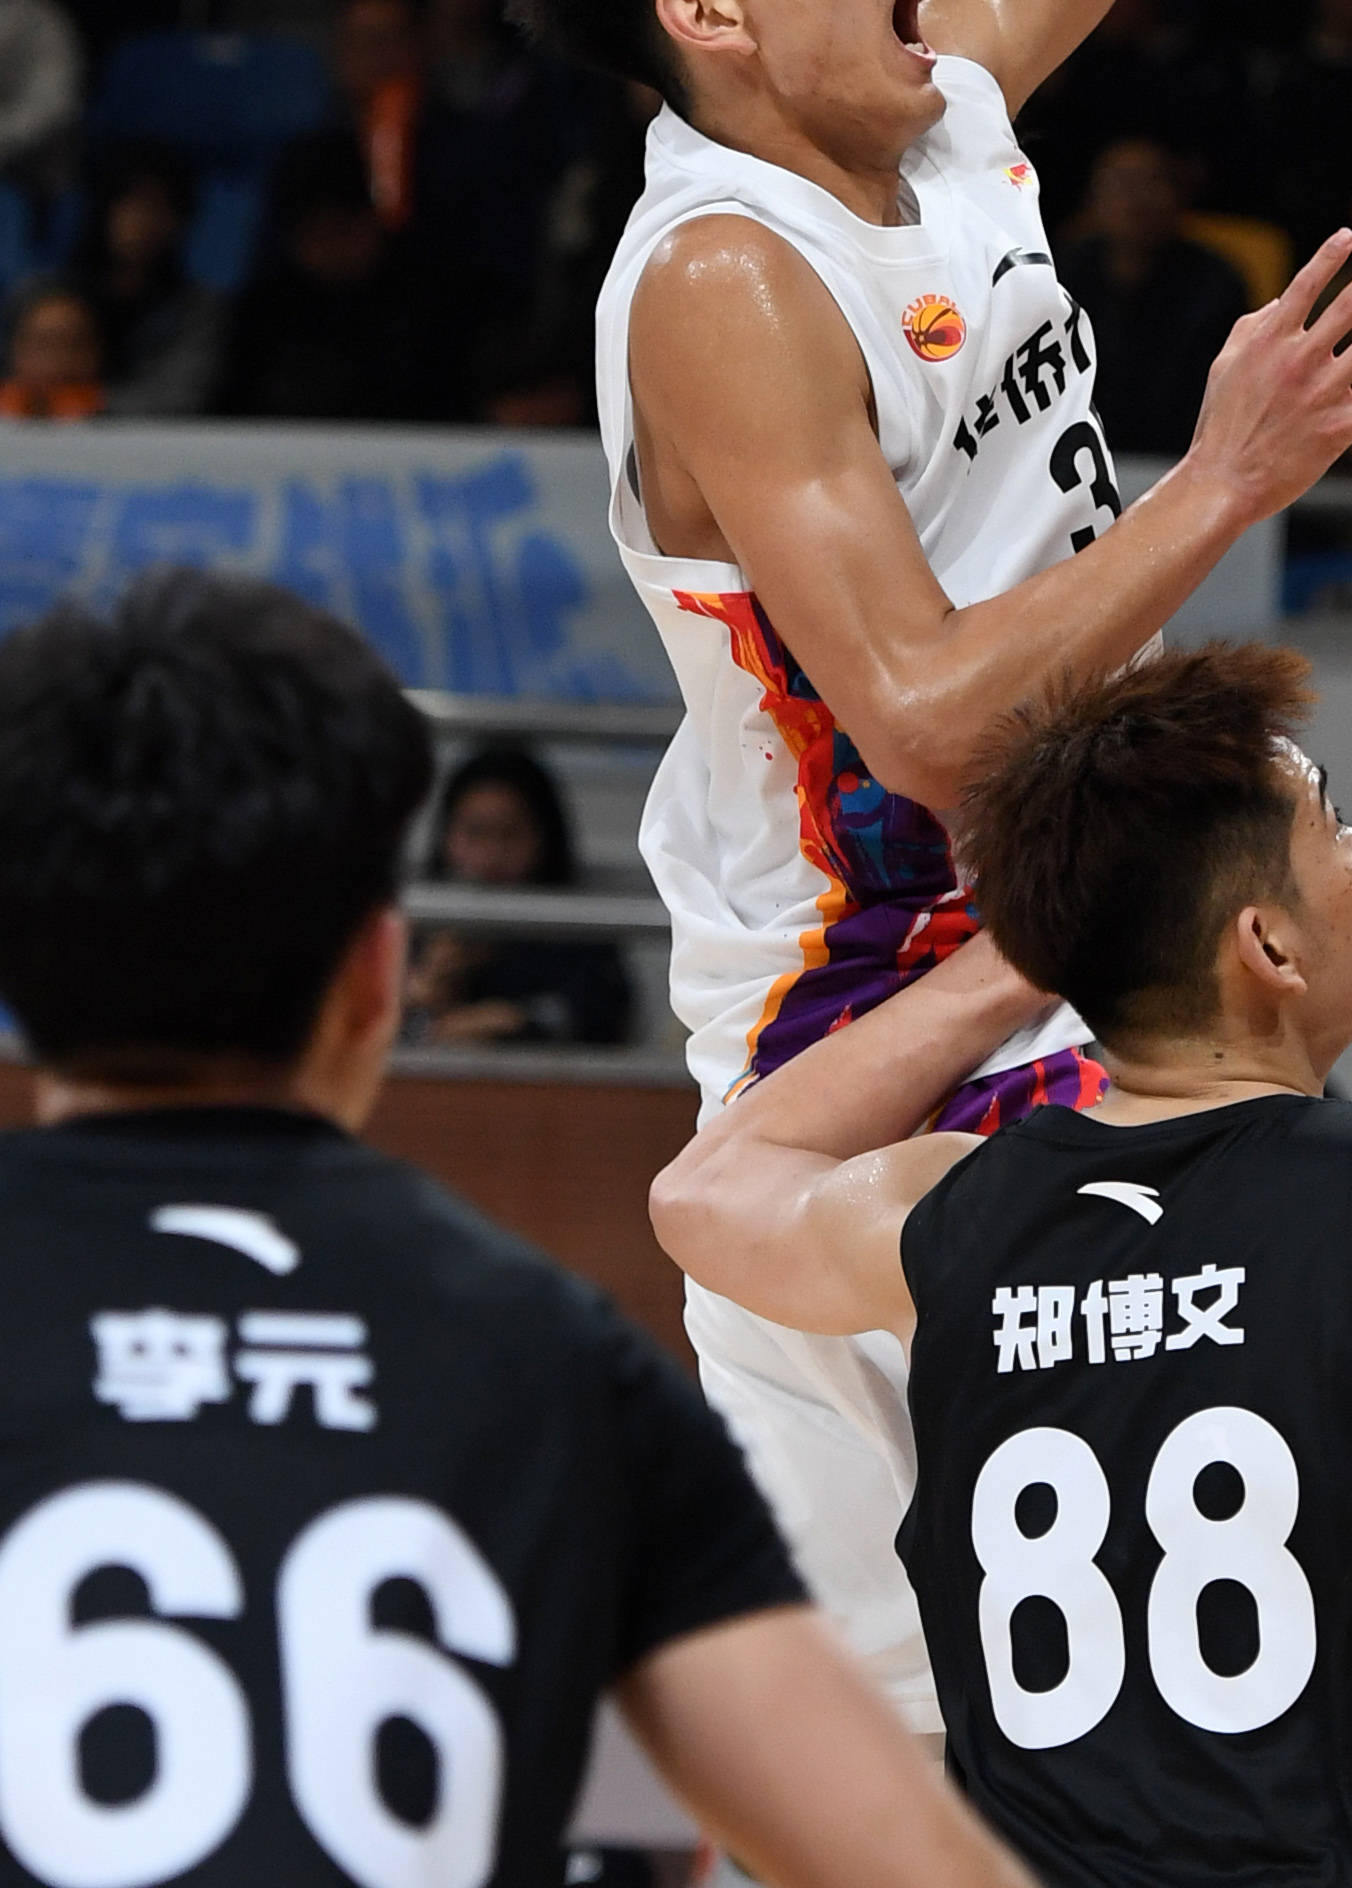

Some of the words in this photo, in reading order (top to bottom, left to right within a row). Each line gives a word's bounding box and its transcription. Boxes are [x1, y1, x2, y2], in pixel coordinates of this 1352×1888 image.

[992, 1263, 1246, 1374] 郑博文
[0, 1476, 519, 1888] 66
[970, 1406, 1318, 1751] 88
